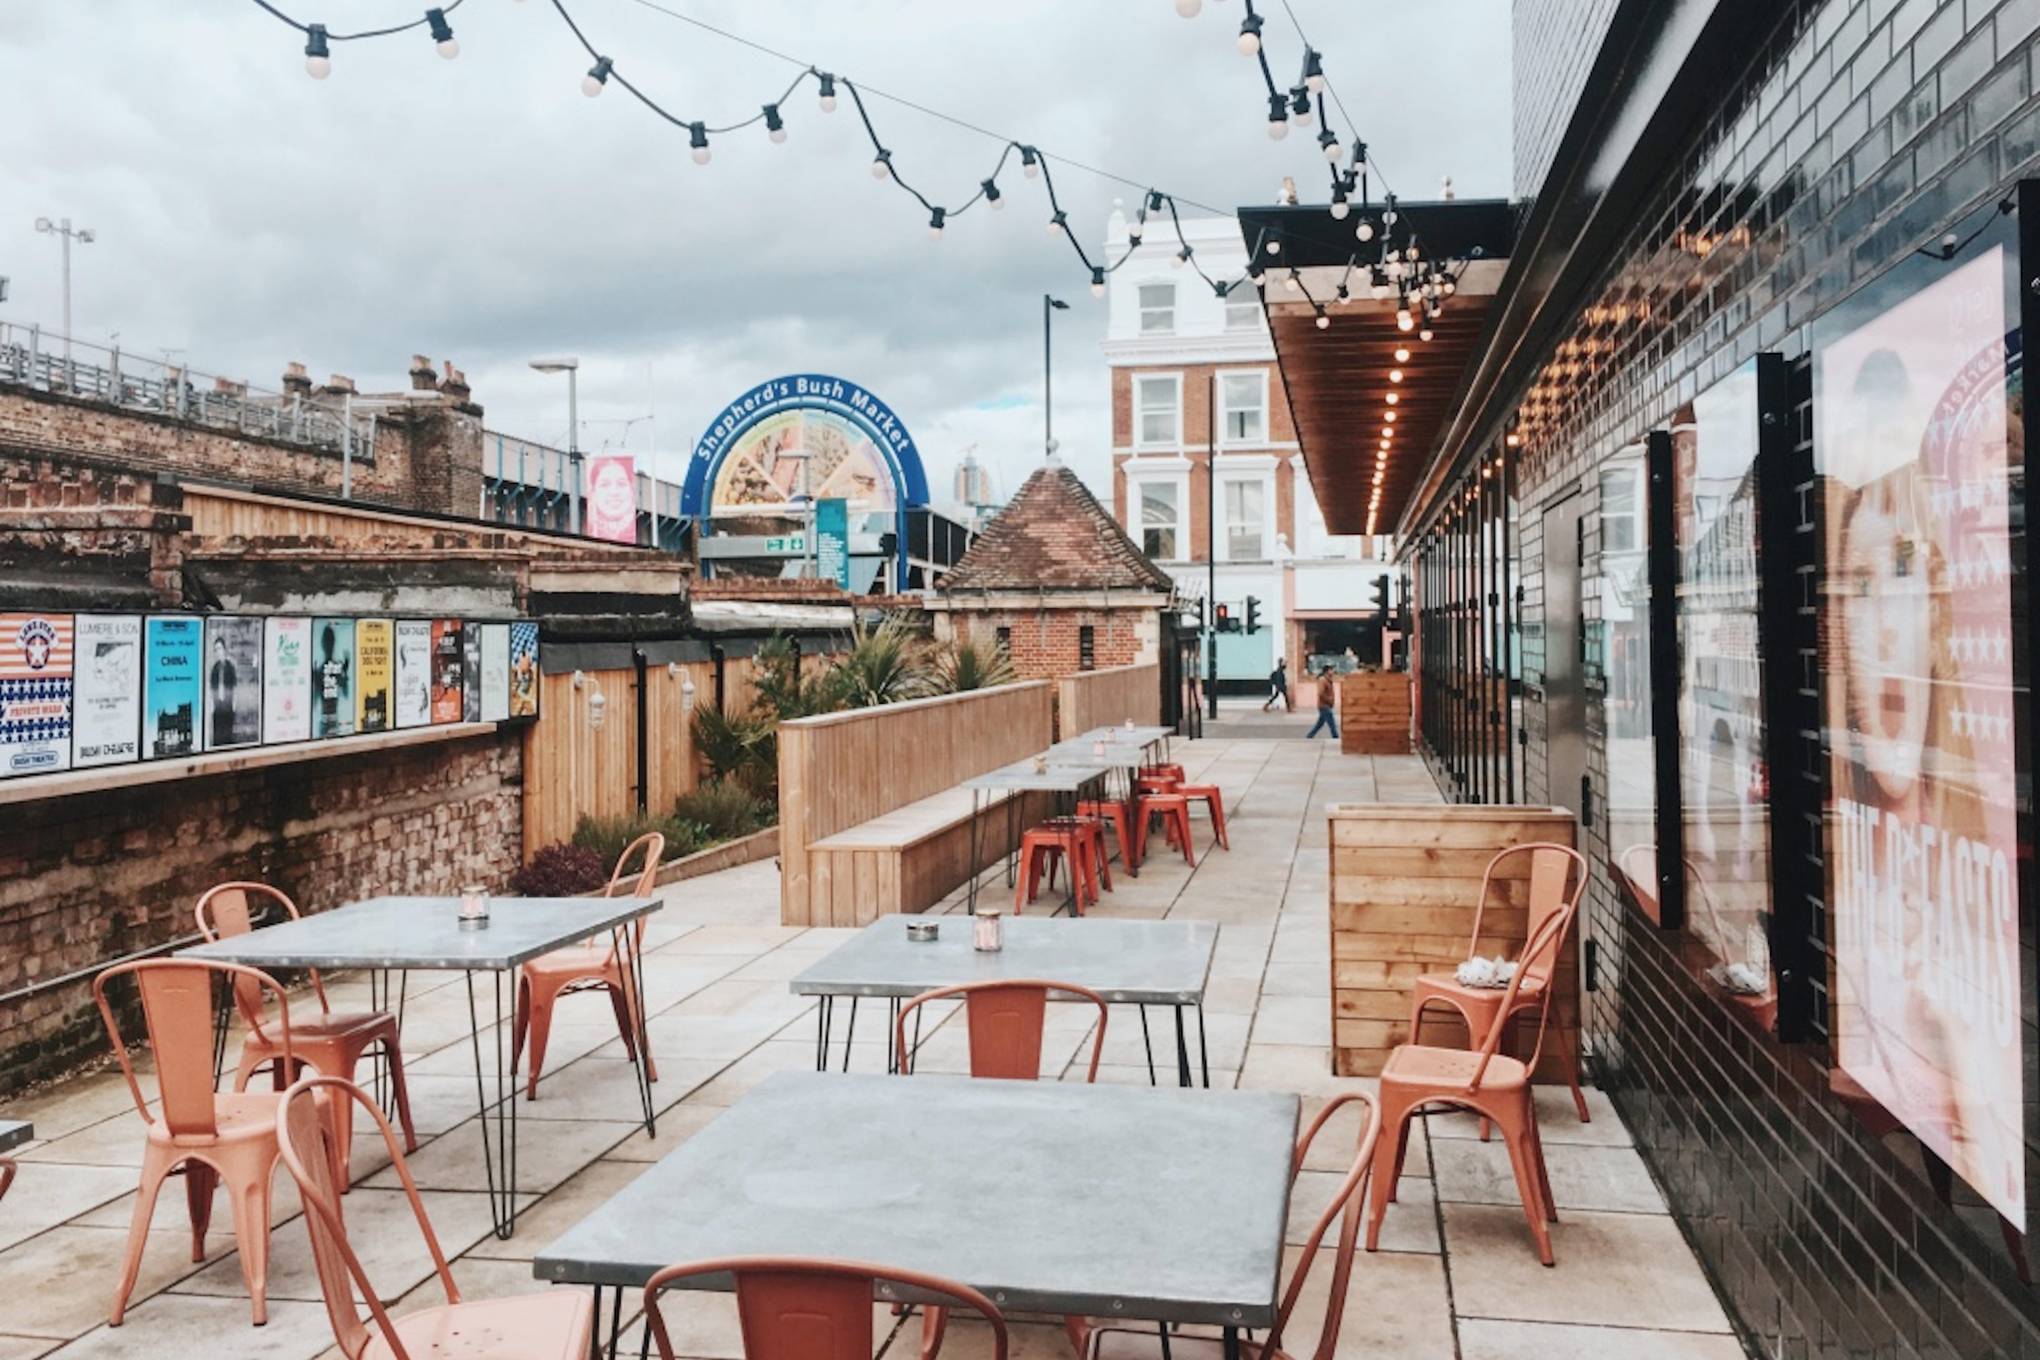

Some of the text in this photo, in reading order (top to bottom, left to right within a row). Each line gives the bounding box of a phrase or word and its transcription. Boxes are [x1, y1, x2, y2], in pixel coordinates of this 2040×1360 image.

[698, 377, 909, 461] Shepherd's Bush Market
[161, 656, 188, 666] CHINA
